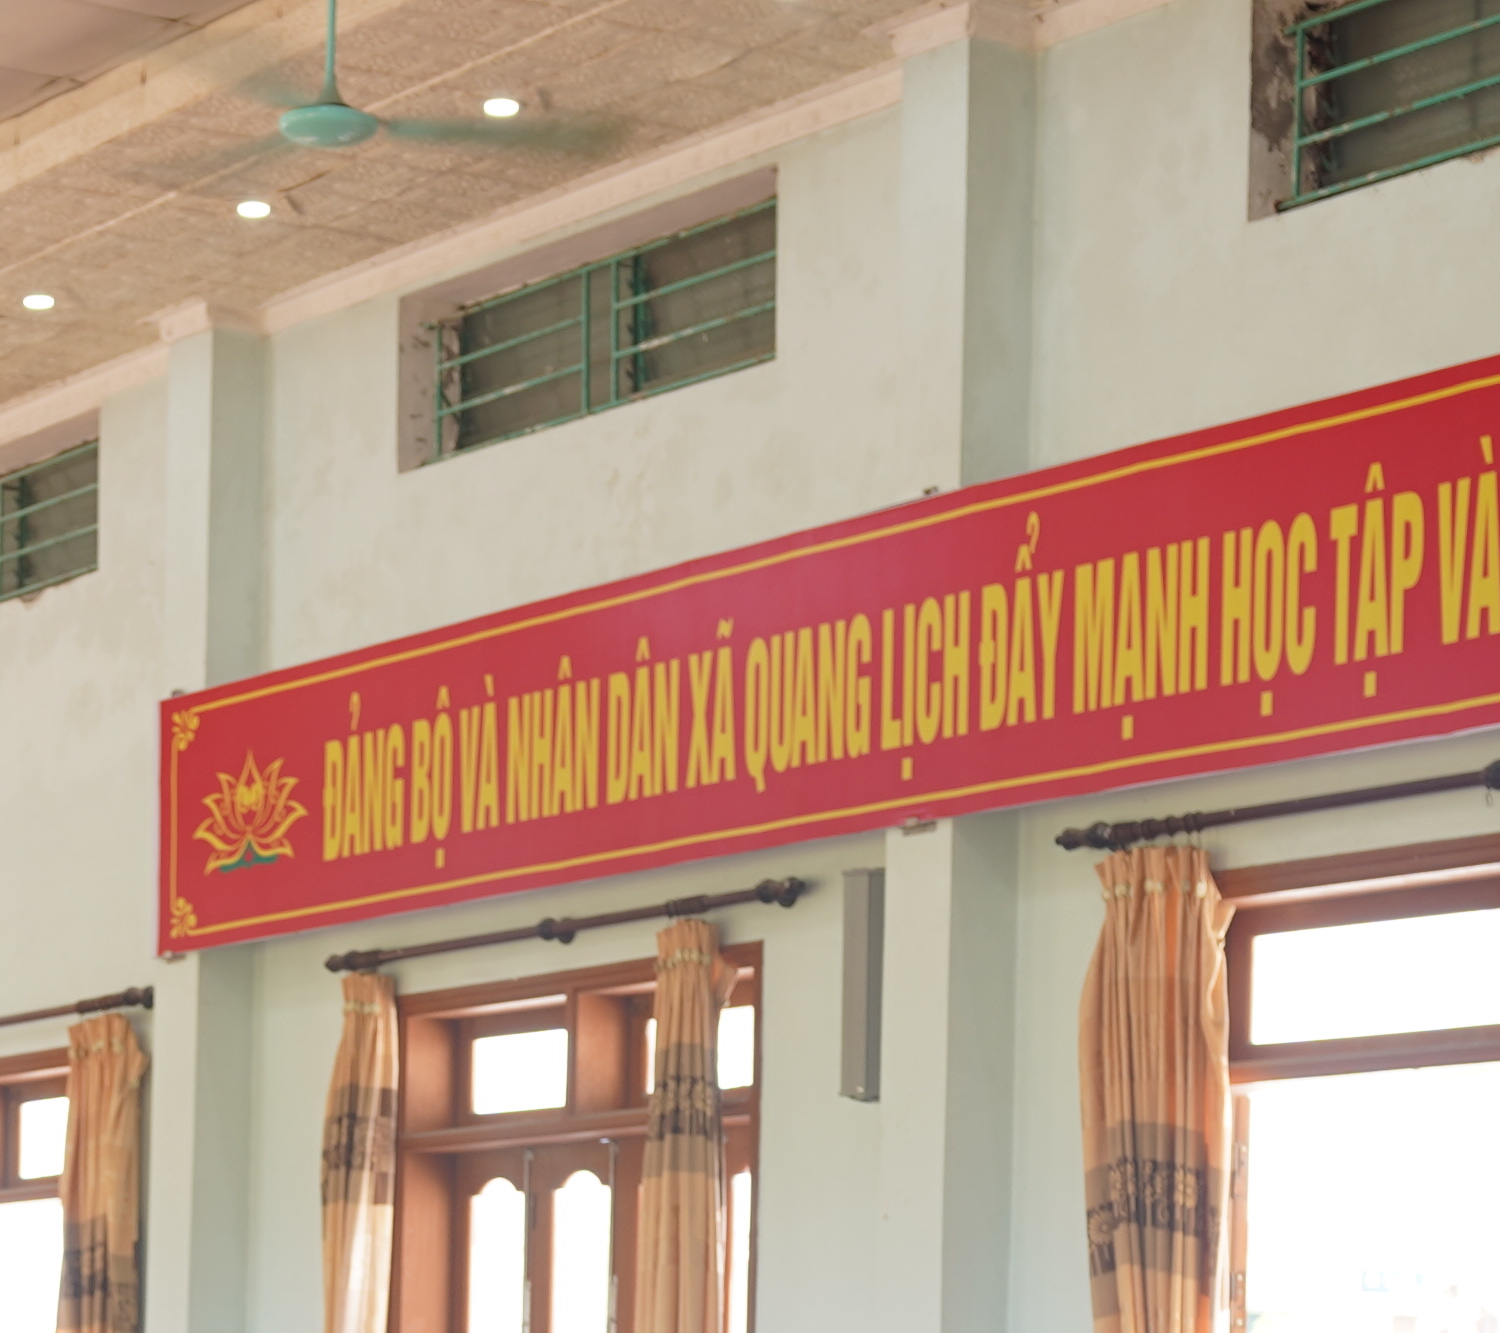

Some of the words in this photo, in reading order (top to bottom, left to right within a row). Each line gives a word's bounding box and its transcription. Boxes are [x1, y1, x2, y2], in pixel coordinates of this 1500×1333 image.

[322, 691, 404, 862] ĐẢNG
[410, 685, 453, 869] BỘ
[459, 673, 499, 834] VÀ
[506, 655, 600, 824] NHÂN
[606, 636, 680, 805] DÂN
[685, 618, 736, 790] XÃ
[744, 613, 872, 793] QUANG
[880, 589, 971, 782] LỊCH
[979, 510, 1065, 732] ĐẨY
[1072, 536, 1210, 740] MẠNH
[1220, 511, 1317, 717] HỌC
[1330, 464, 1423, 698] TẬP
